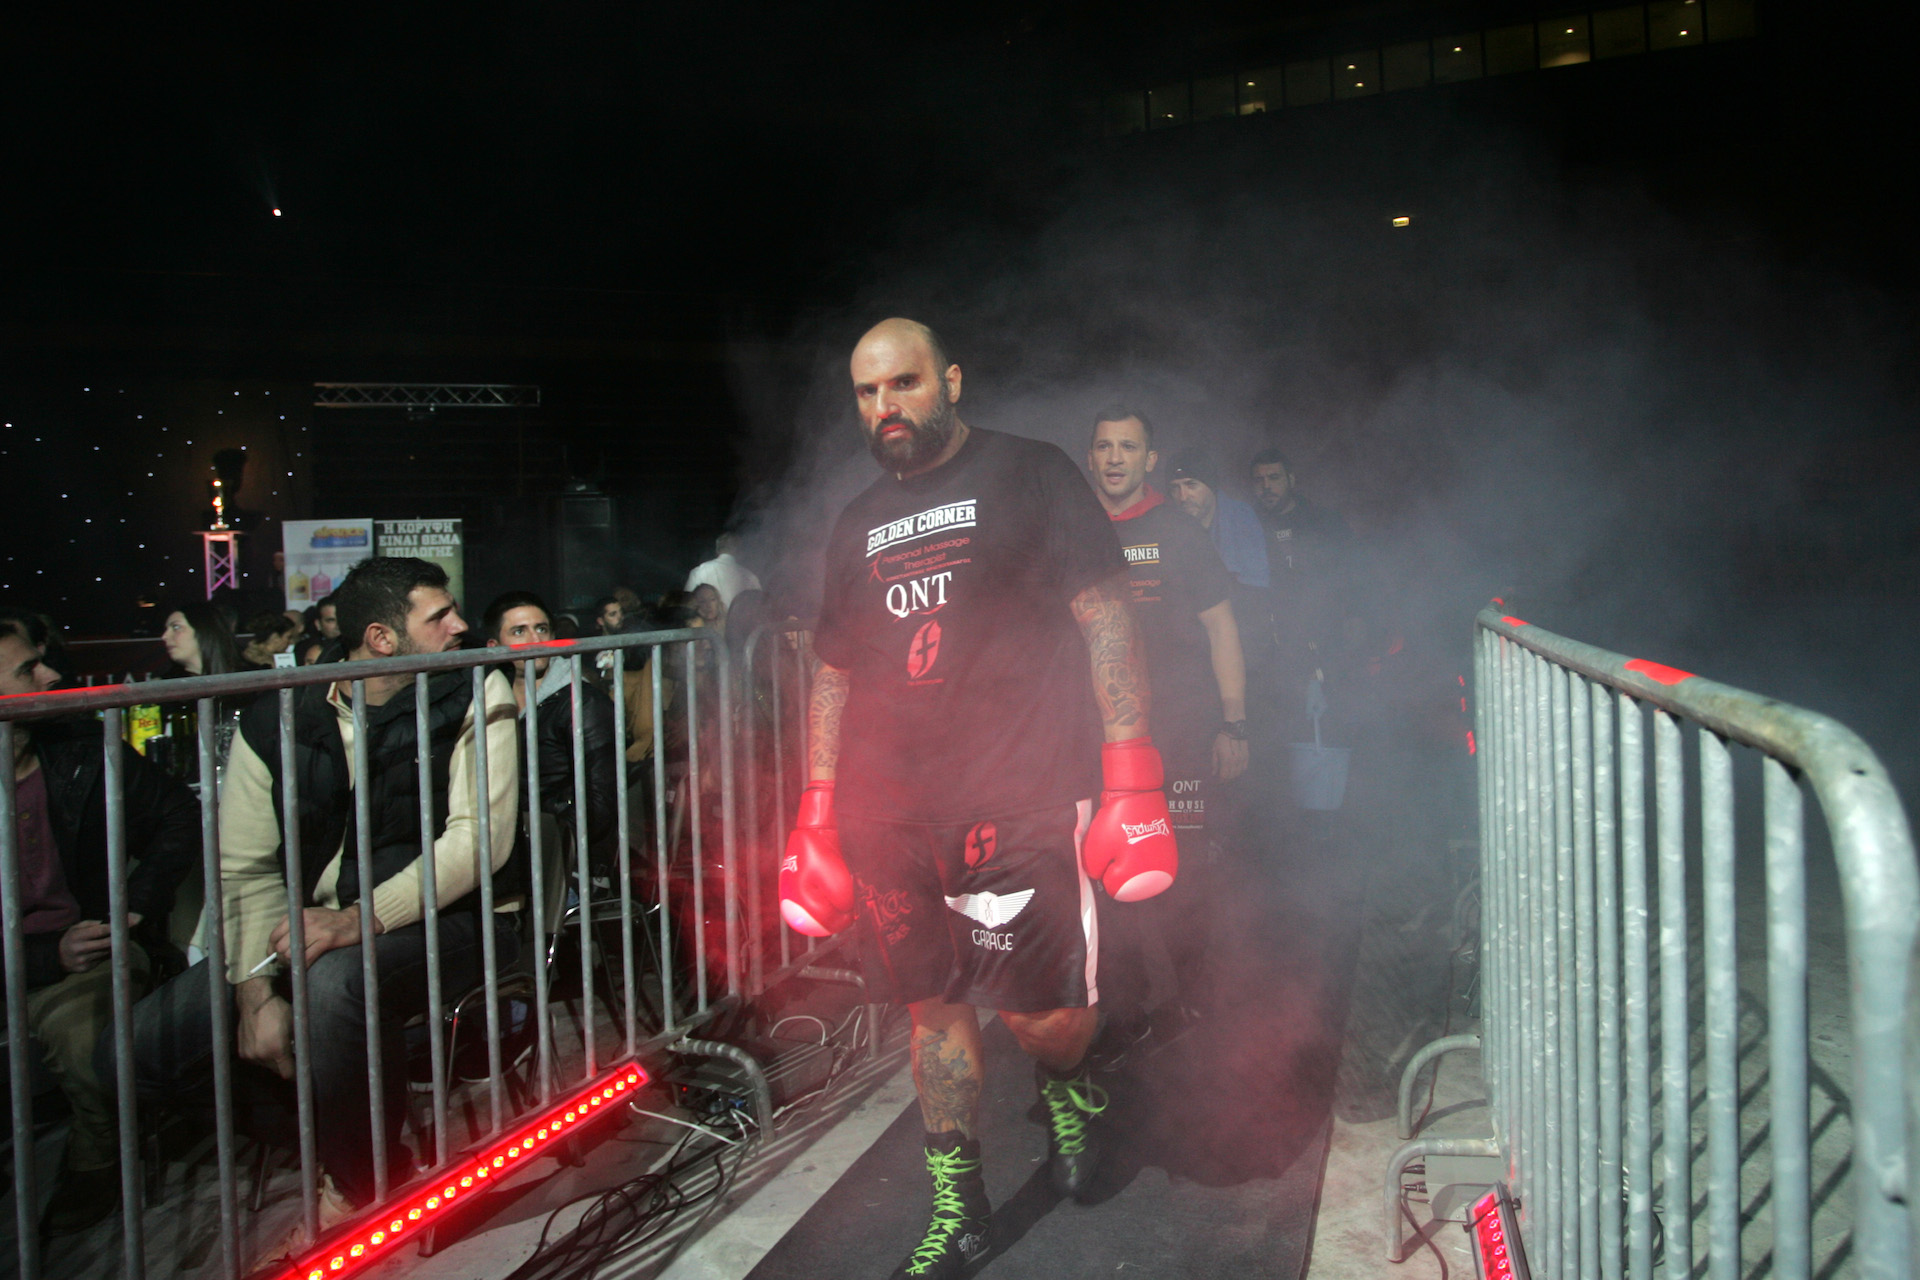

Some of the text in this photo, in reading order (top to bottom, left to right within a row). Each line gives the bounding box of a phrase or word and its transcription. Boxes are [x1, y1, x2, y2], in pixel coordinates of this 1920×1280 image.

[384, 523, 395, 535] Η
[867, 505, 976, 552] GOLDEN CORNER
[379, 535, 418, 547] ΕΙΝΑΙ
[421, 534, 461, 546] ΘΕΜΑ
[386, 546, 454, 559] ΕΠΙΛΟΓΗΣ
[882, 537, 971, 565] Personal Massage
[903, 552, 947, 571] Therapist
[886, 571, 952, 618] QNT
[1173, 780, 1201, 794] QNT
[972, 929, 1014, 951] GARAGE
